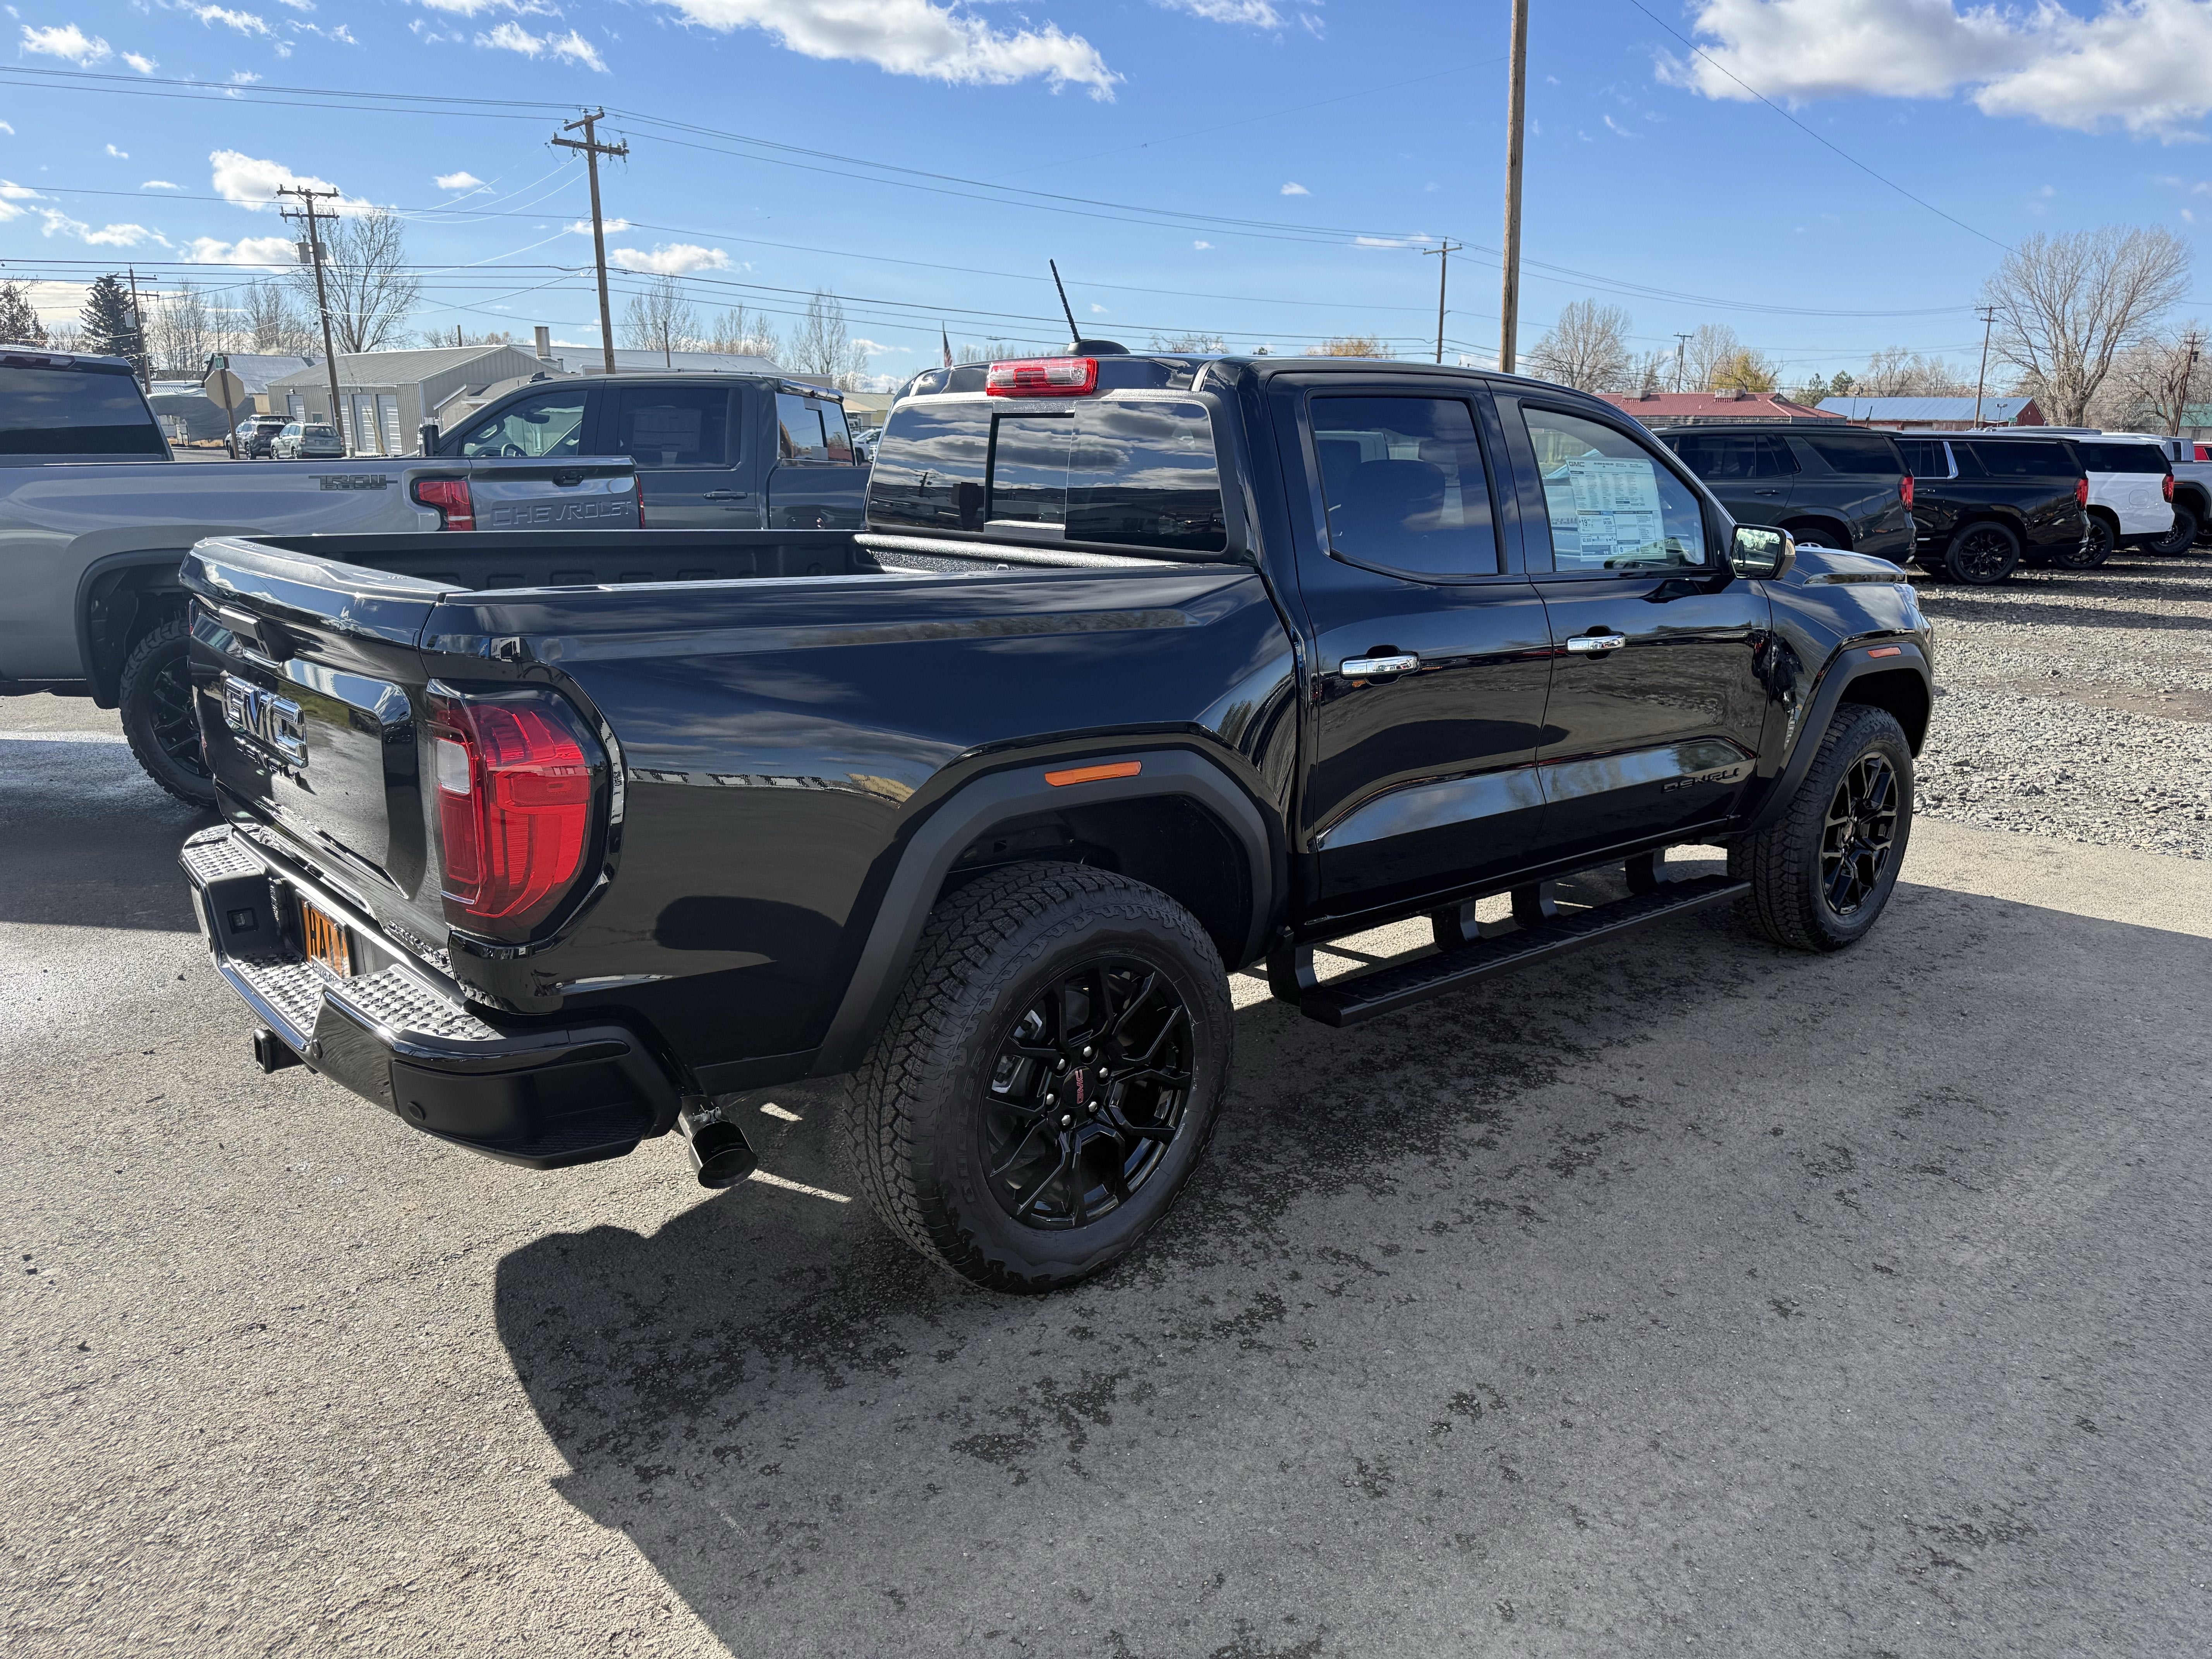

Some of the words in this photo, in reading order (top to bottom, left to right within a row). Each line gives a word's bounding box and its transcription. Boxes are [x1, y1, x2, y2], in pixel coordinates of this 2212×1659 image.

[309, 475, 398, 484] TRAIL
[492, 500, 631, 526] CHEVROLET
[222, 672, 309, 769] GMC
[1661, 768, 1740, 793] DENALI
[1075, 1069, 1084, 1104] GMC
[1187, 980, 1223, 1164] BRIDGESTONE
